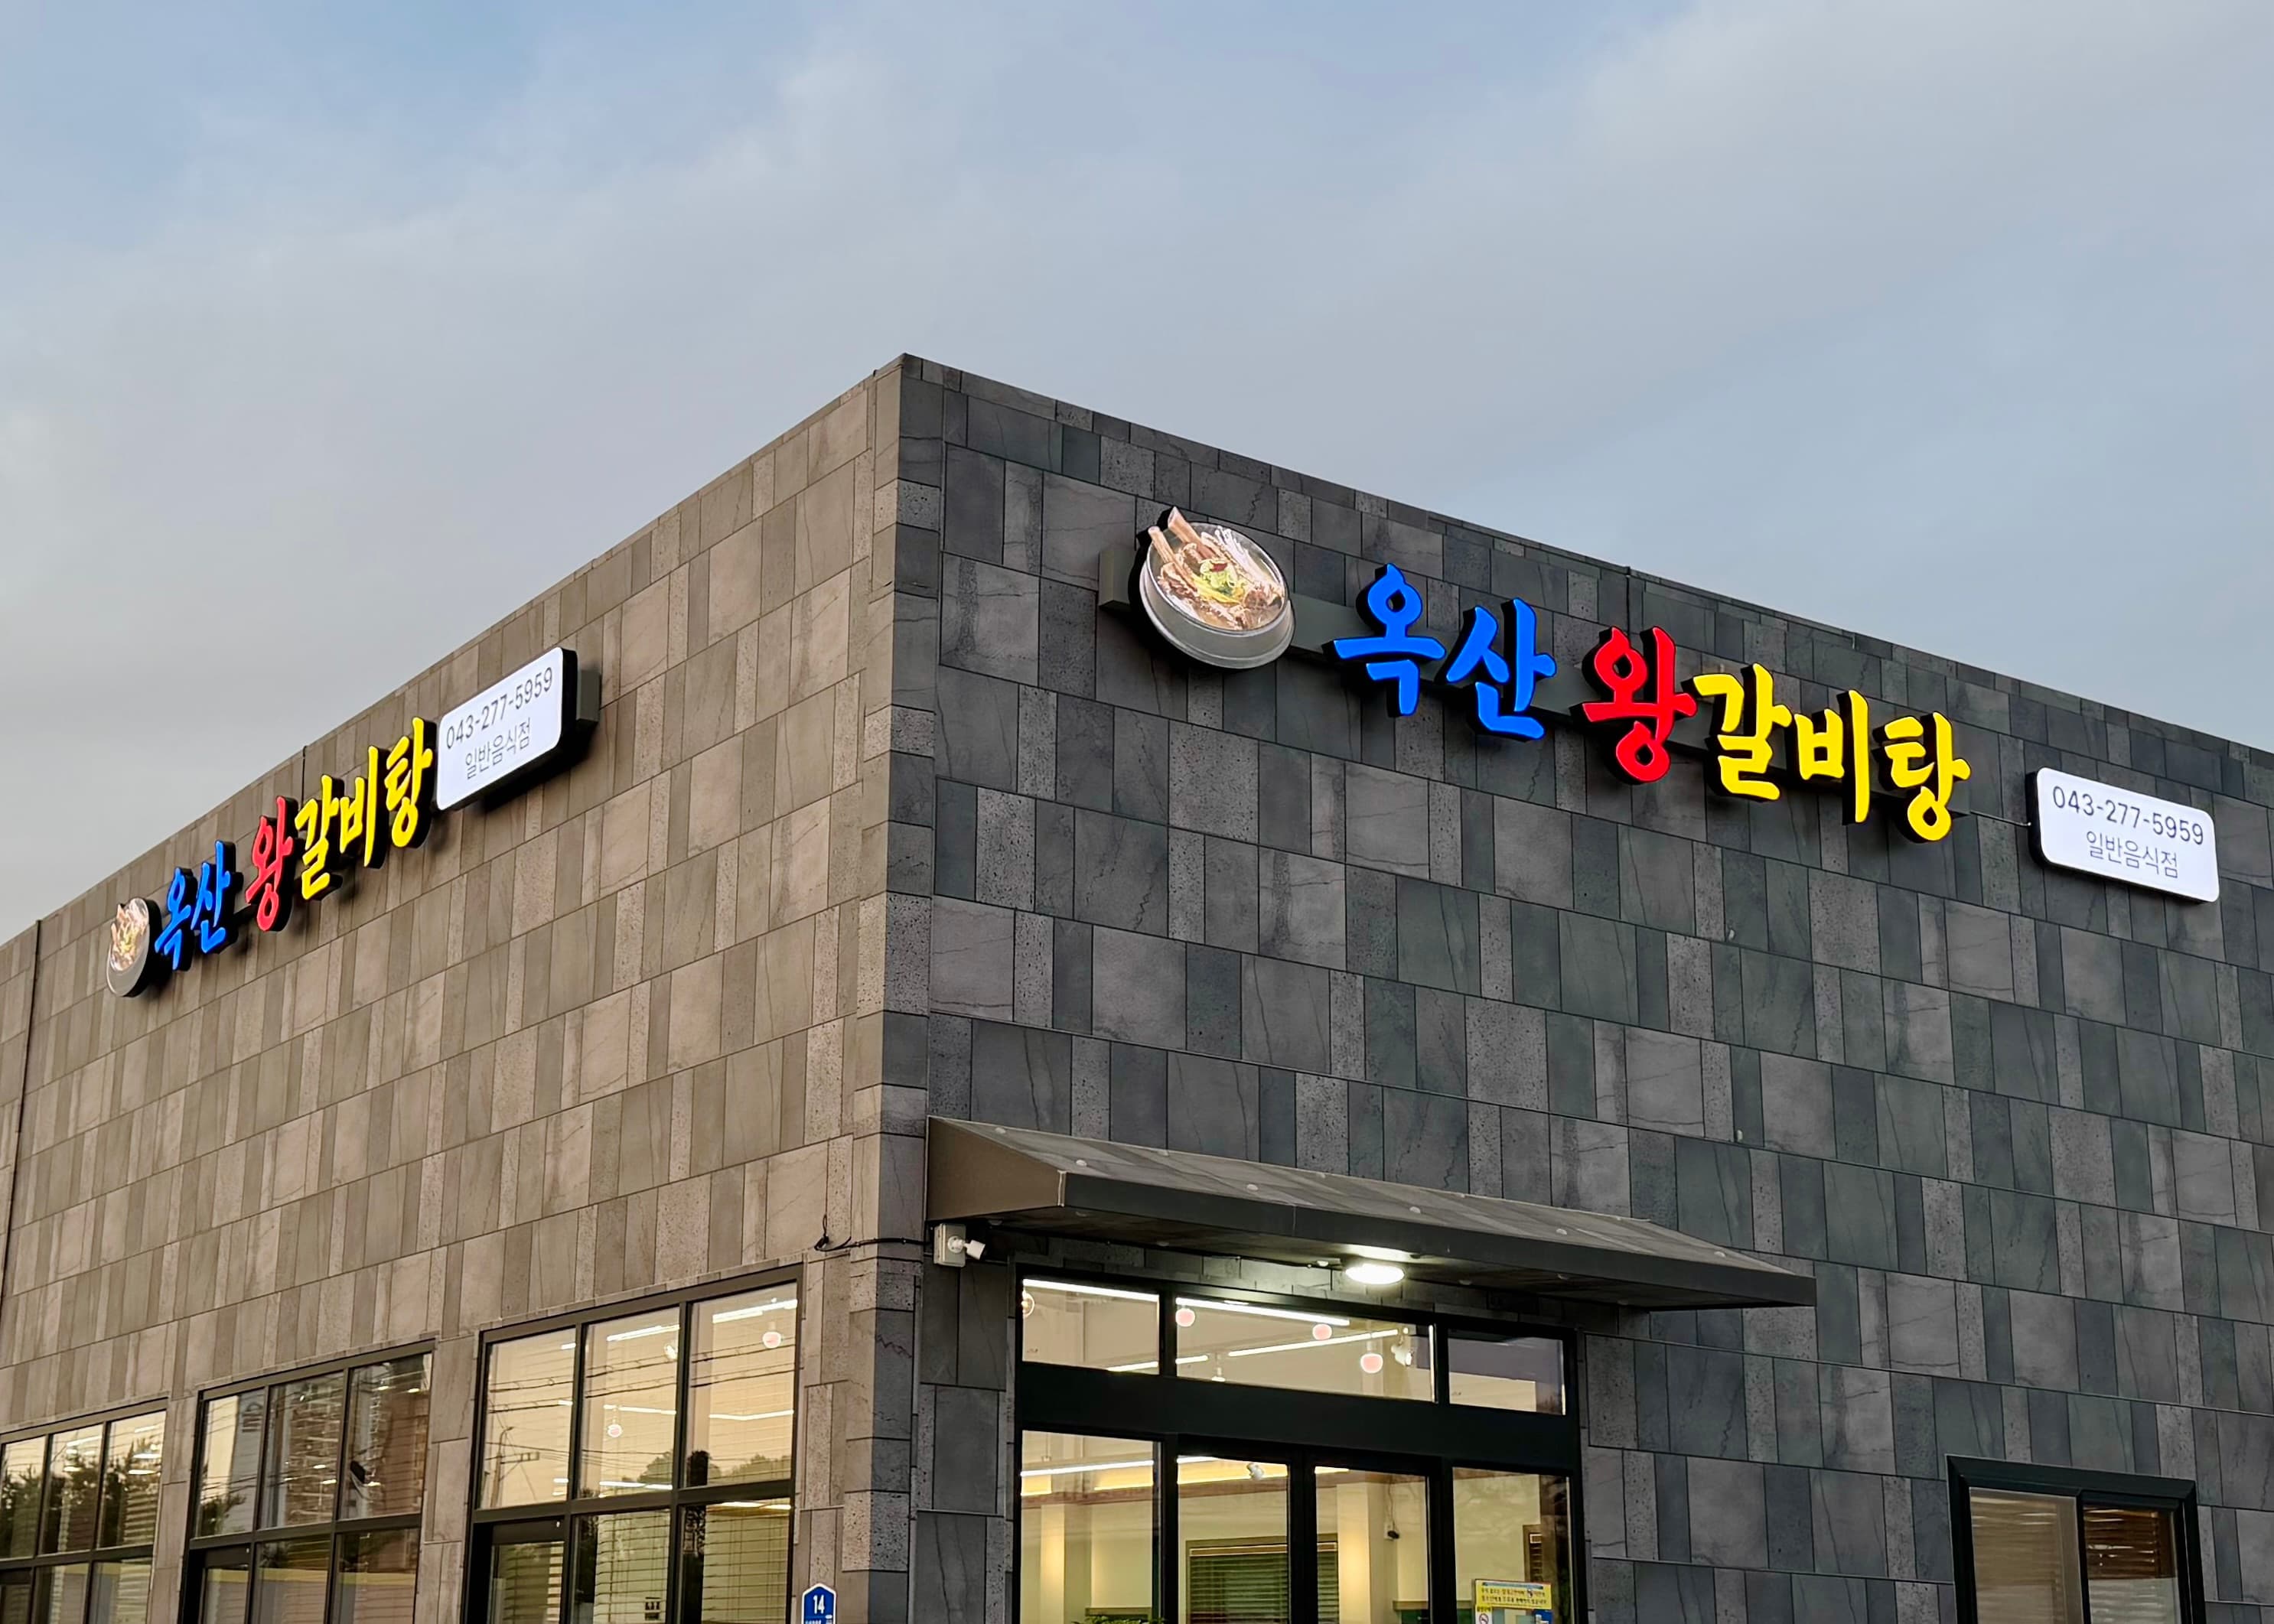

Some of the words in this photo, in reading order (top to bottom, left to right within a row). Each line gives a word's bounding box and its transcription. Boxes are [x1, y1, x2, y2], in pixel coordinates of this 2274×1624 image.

[1334, 563, 1558, 740] 옥산
[446, 667, 552, 750] 043-277-5959
[465, 717, 531, 779] 일반음식점
[2053, 786, 2204, 845] 043-277-5959
[2087, 831, 2178, 878] 일반음식점
[813, 1594, 825, 1614] 14
